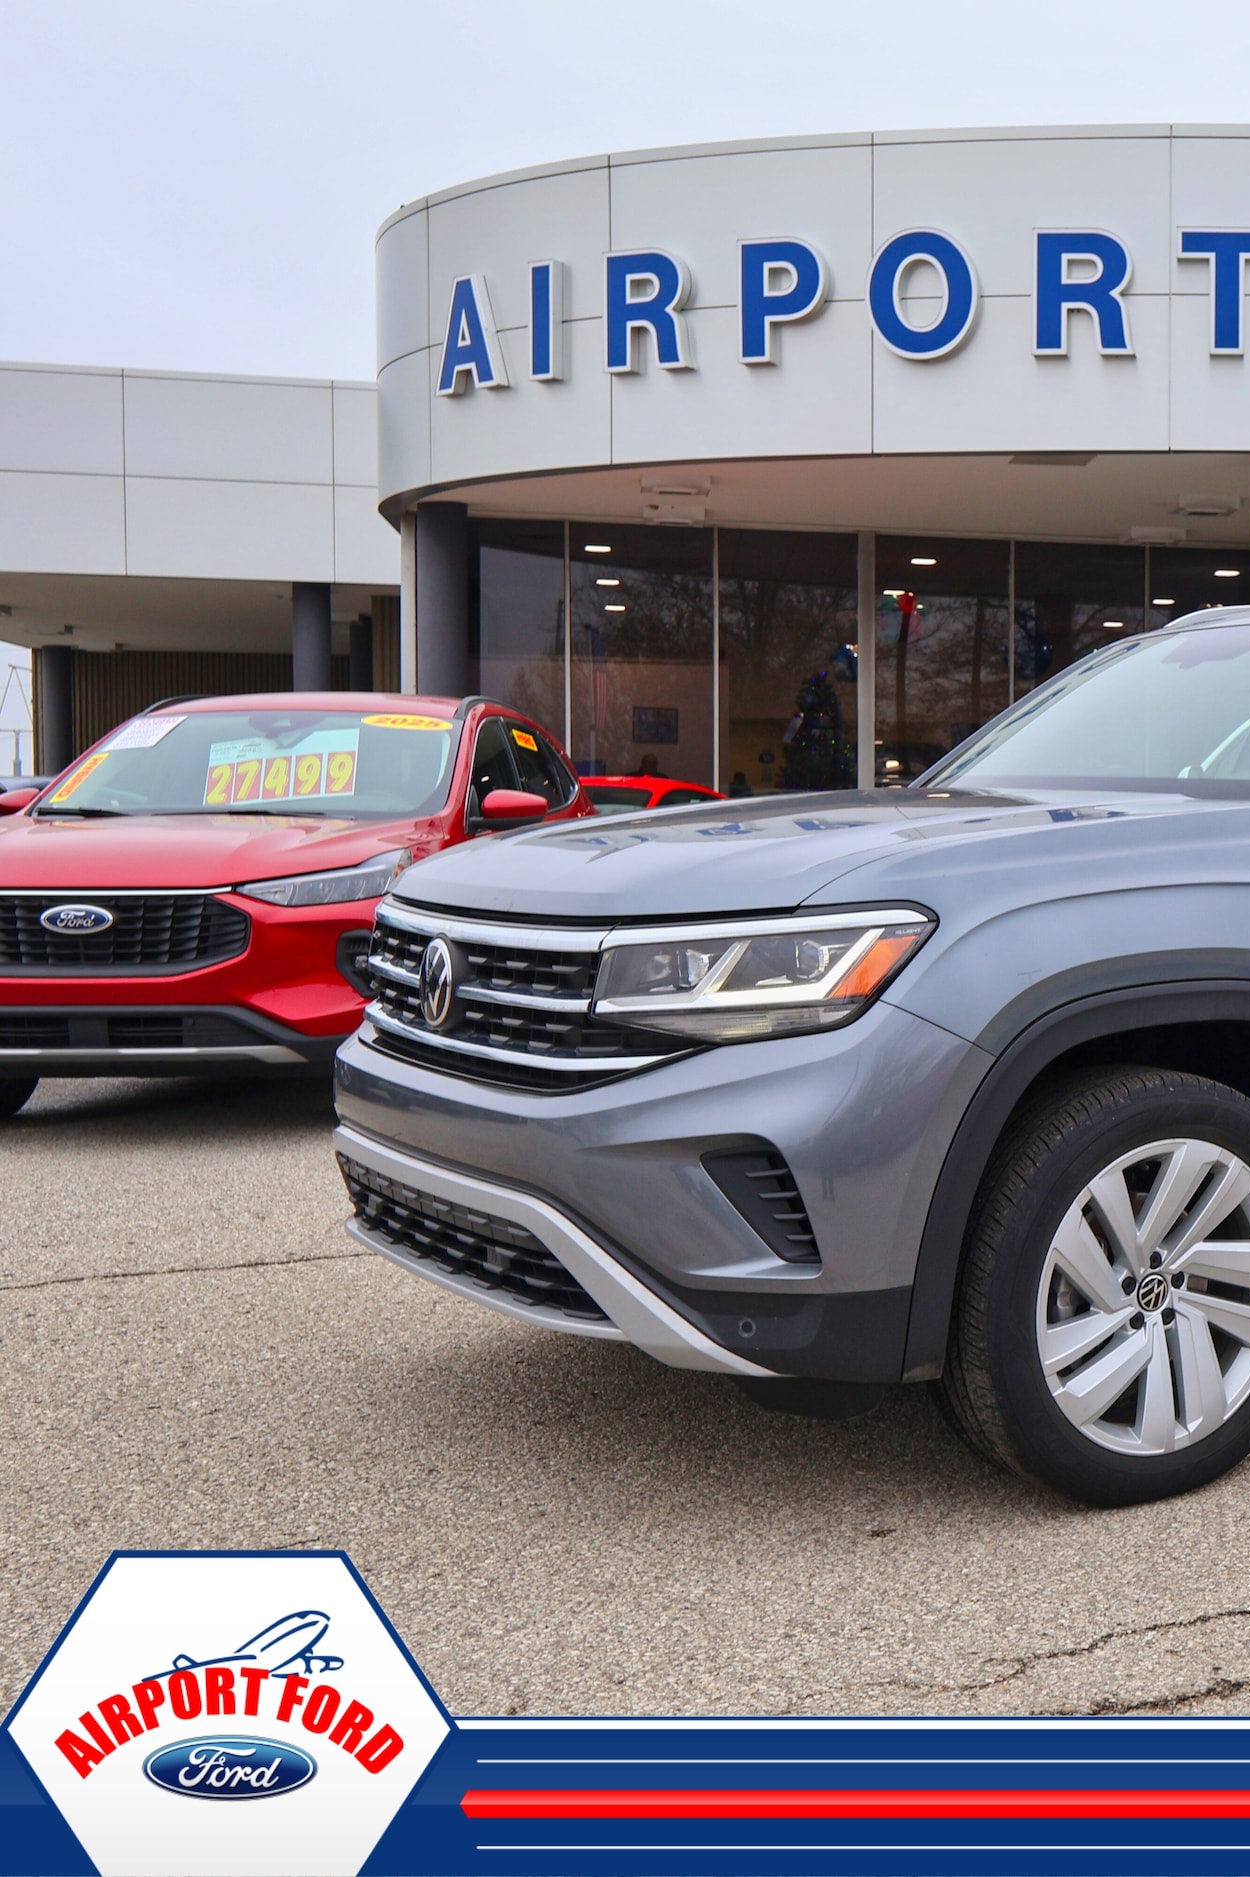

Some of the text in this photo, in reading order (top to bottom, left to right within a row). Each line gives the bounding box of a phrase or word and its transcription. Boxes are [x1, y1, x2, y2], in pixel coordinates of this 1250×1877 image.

[371, 716, 441, 729] 2025
[206, 752, 355, 805] 27499
[56, 910, 96, 928] Ford
